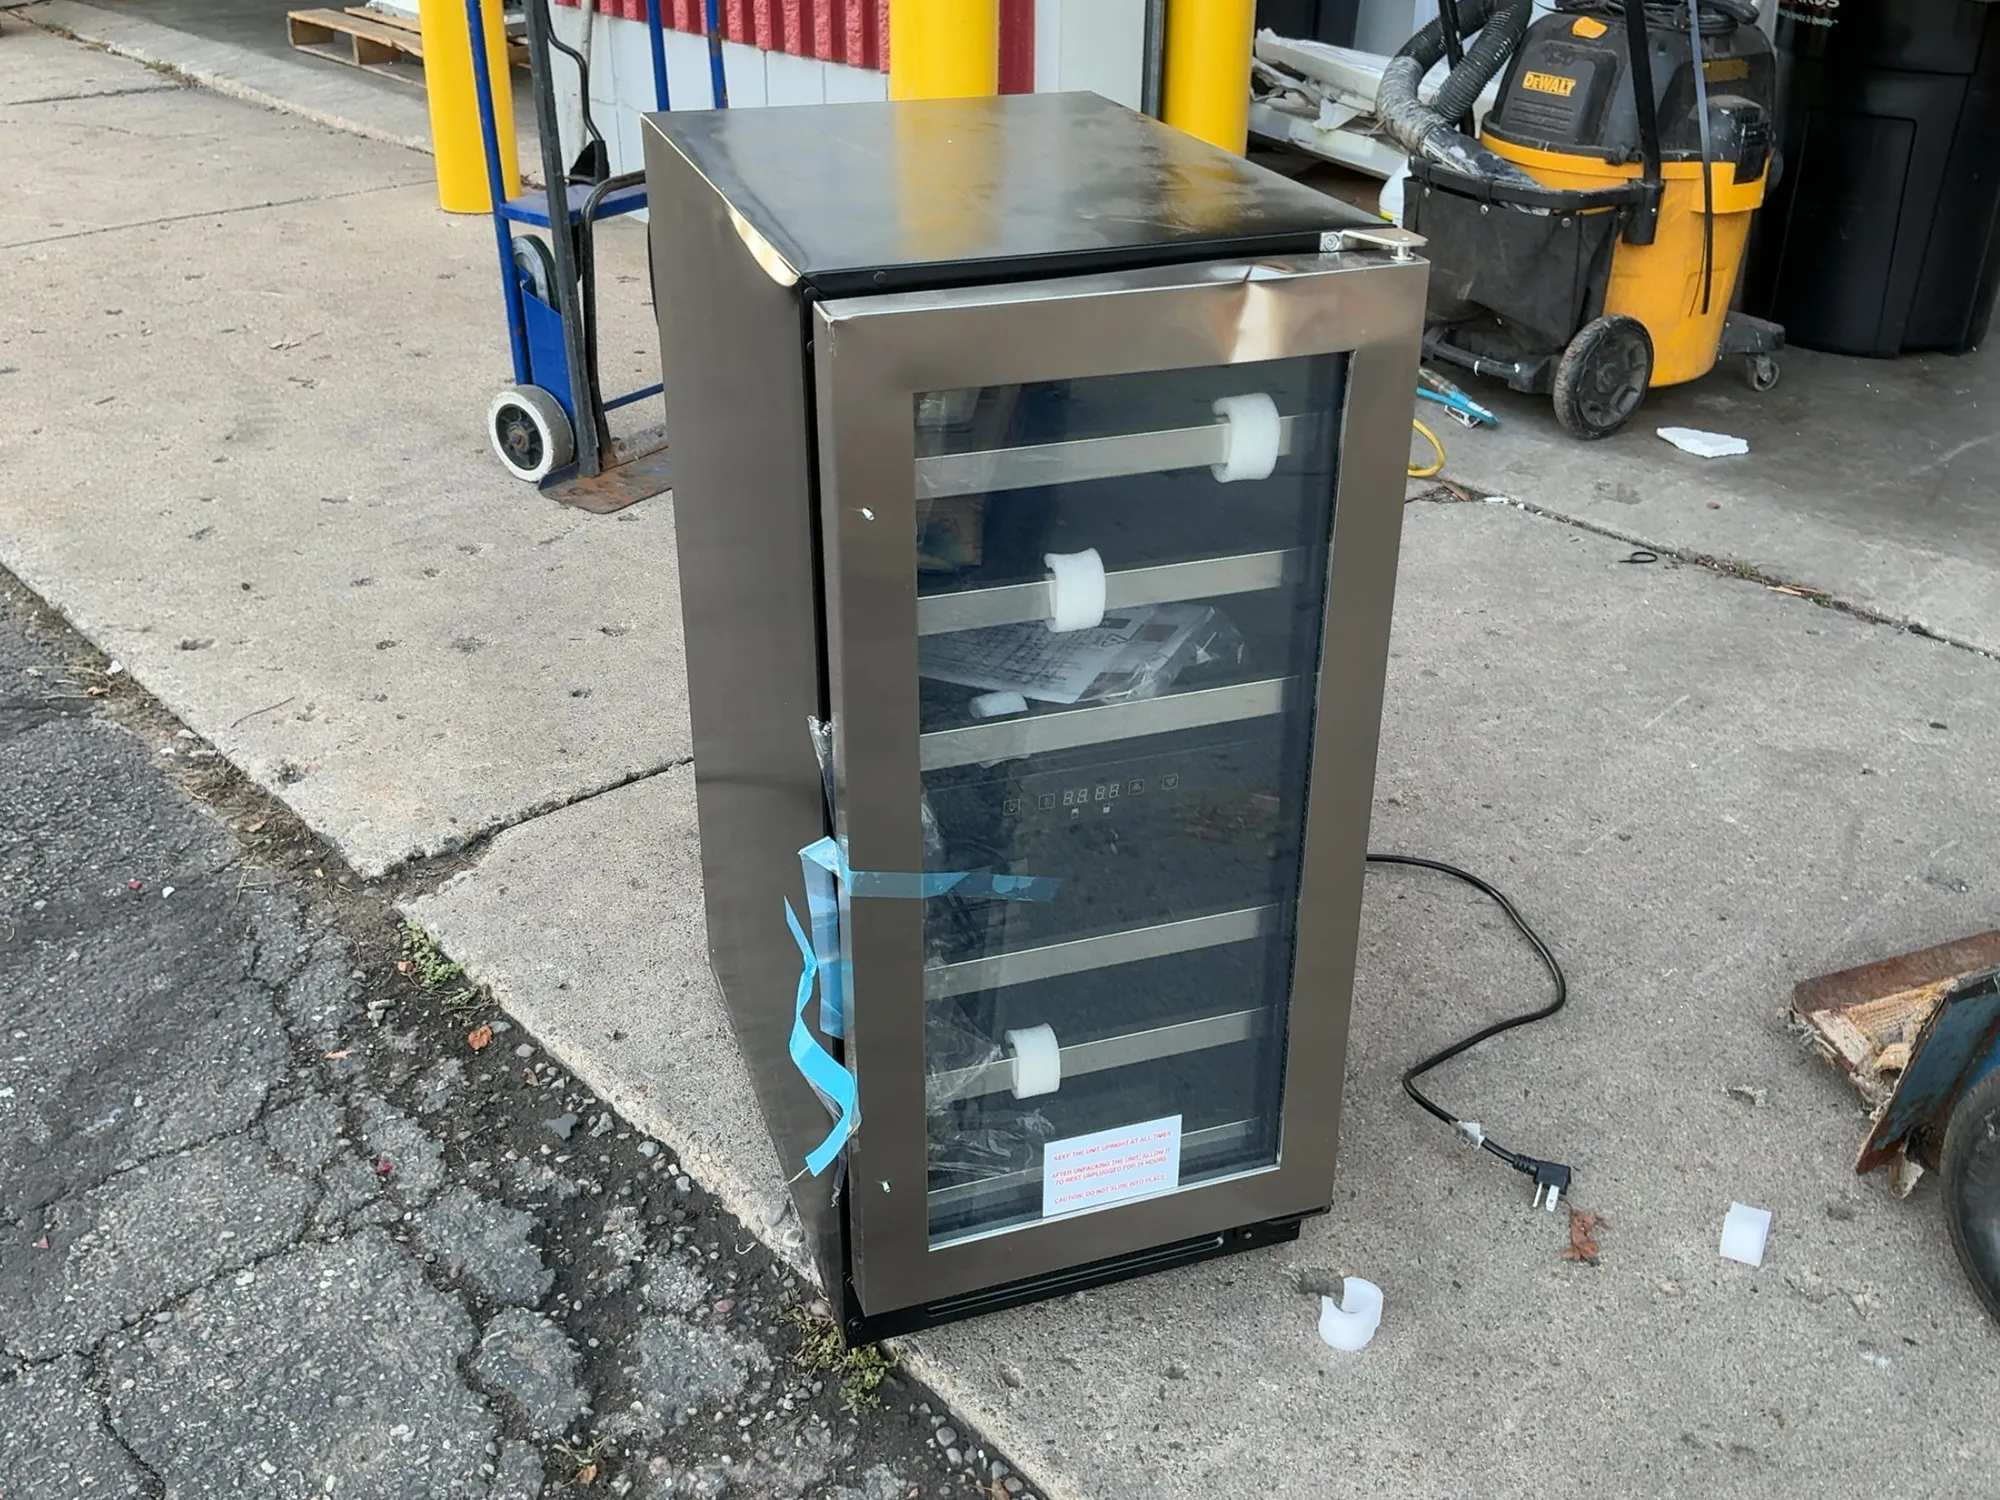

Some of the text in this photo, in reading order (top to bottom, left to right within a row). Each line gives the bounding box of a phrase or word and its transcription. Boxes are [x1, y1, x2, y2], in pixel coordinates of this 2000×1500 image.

[1054, 1152, 1071, 1161] KEEP
[1086, 1146, 1101, 1154] UNIT
[1101, 1140, 1129, 1151] UPRIGHT
[1153, 1131, 1172, 1140] TIMES
[1052, 1169, 1073, 1178] AFTER
[1073, 1161, 1111, 1174] UNPACKING
[1111, 1158, 1123, 1166] THE
[1142, 1149, 1165, 1159] ALLOW
[1055, 1156, 1167, 1186] TO REST UNPLUGGED FOR 24 HOURS
[1096, 1186, 1110, 1195] NOT
[1110, 1182, 1129, 1191] SLIDE
[1129, 1178, 1144, 1187] INTO
